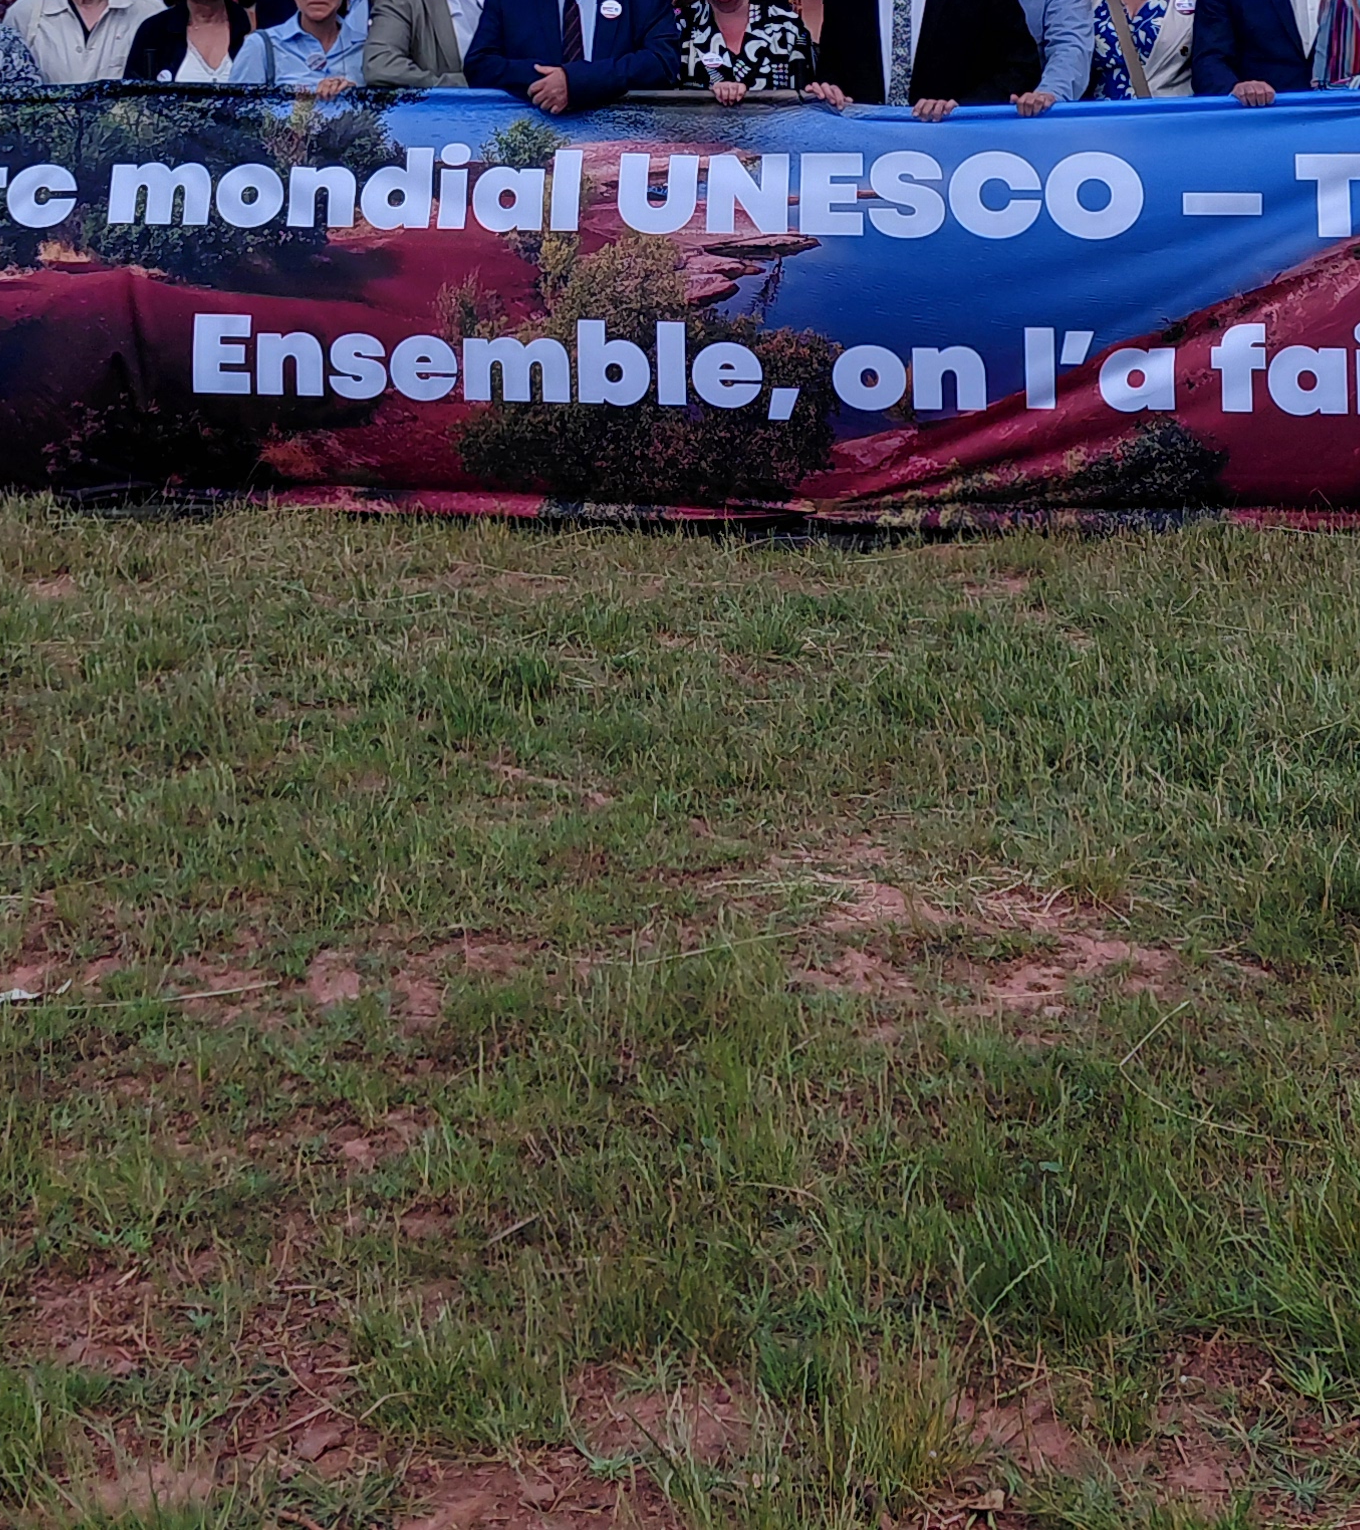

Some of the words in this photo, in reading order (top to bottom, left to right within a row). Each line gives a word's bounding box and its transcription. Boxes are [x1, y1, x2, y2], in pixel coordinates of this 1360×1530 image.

[107, 143, 583, 233] mondial
[618, 151, 1144, 239] UNESCO
[193, 313, 800, 421] Ensemble,
[832, 345, 987, 411] on
[1024, 327, 1176, 412] l'a
